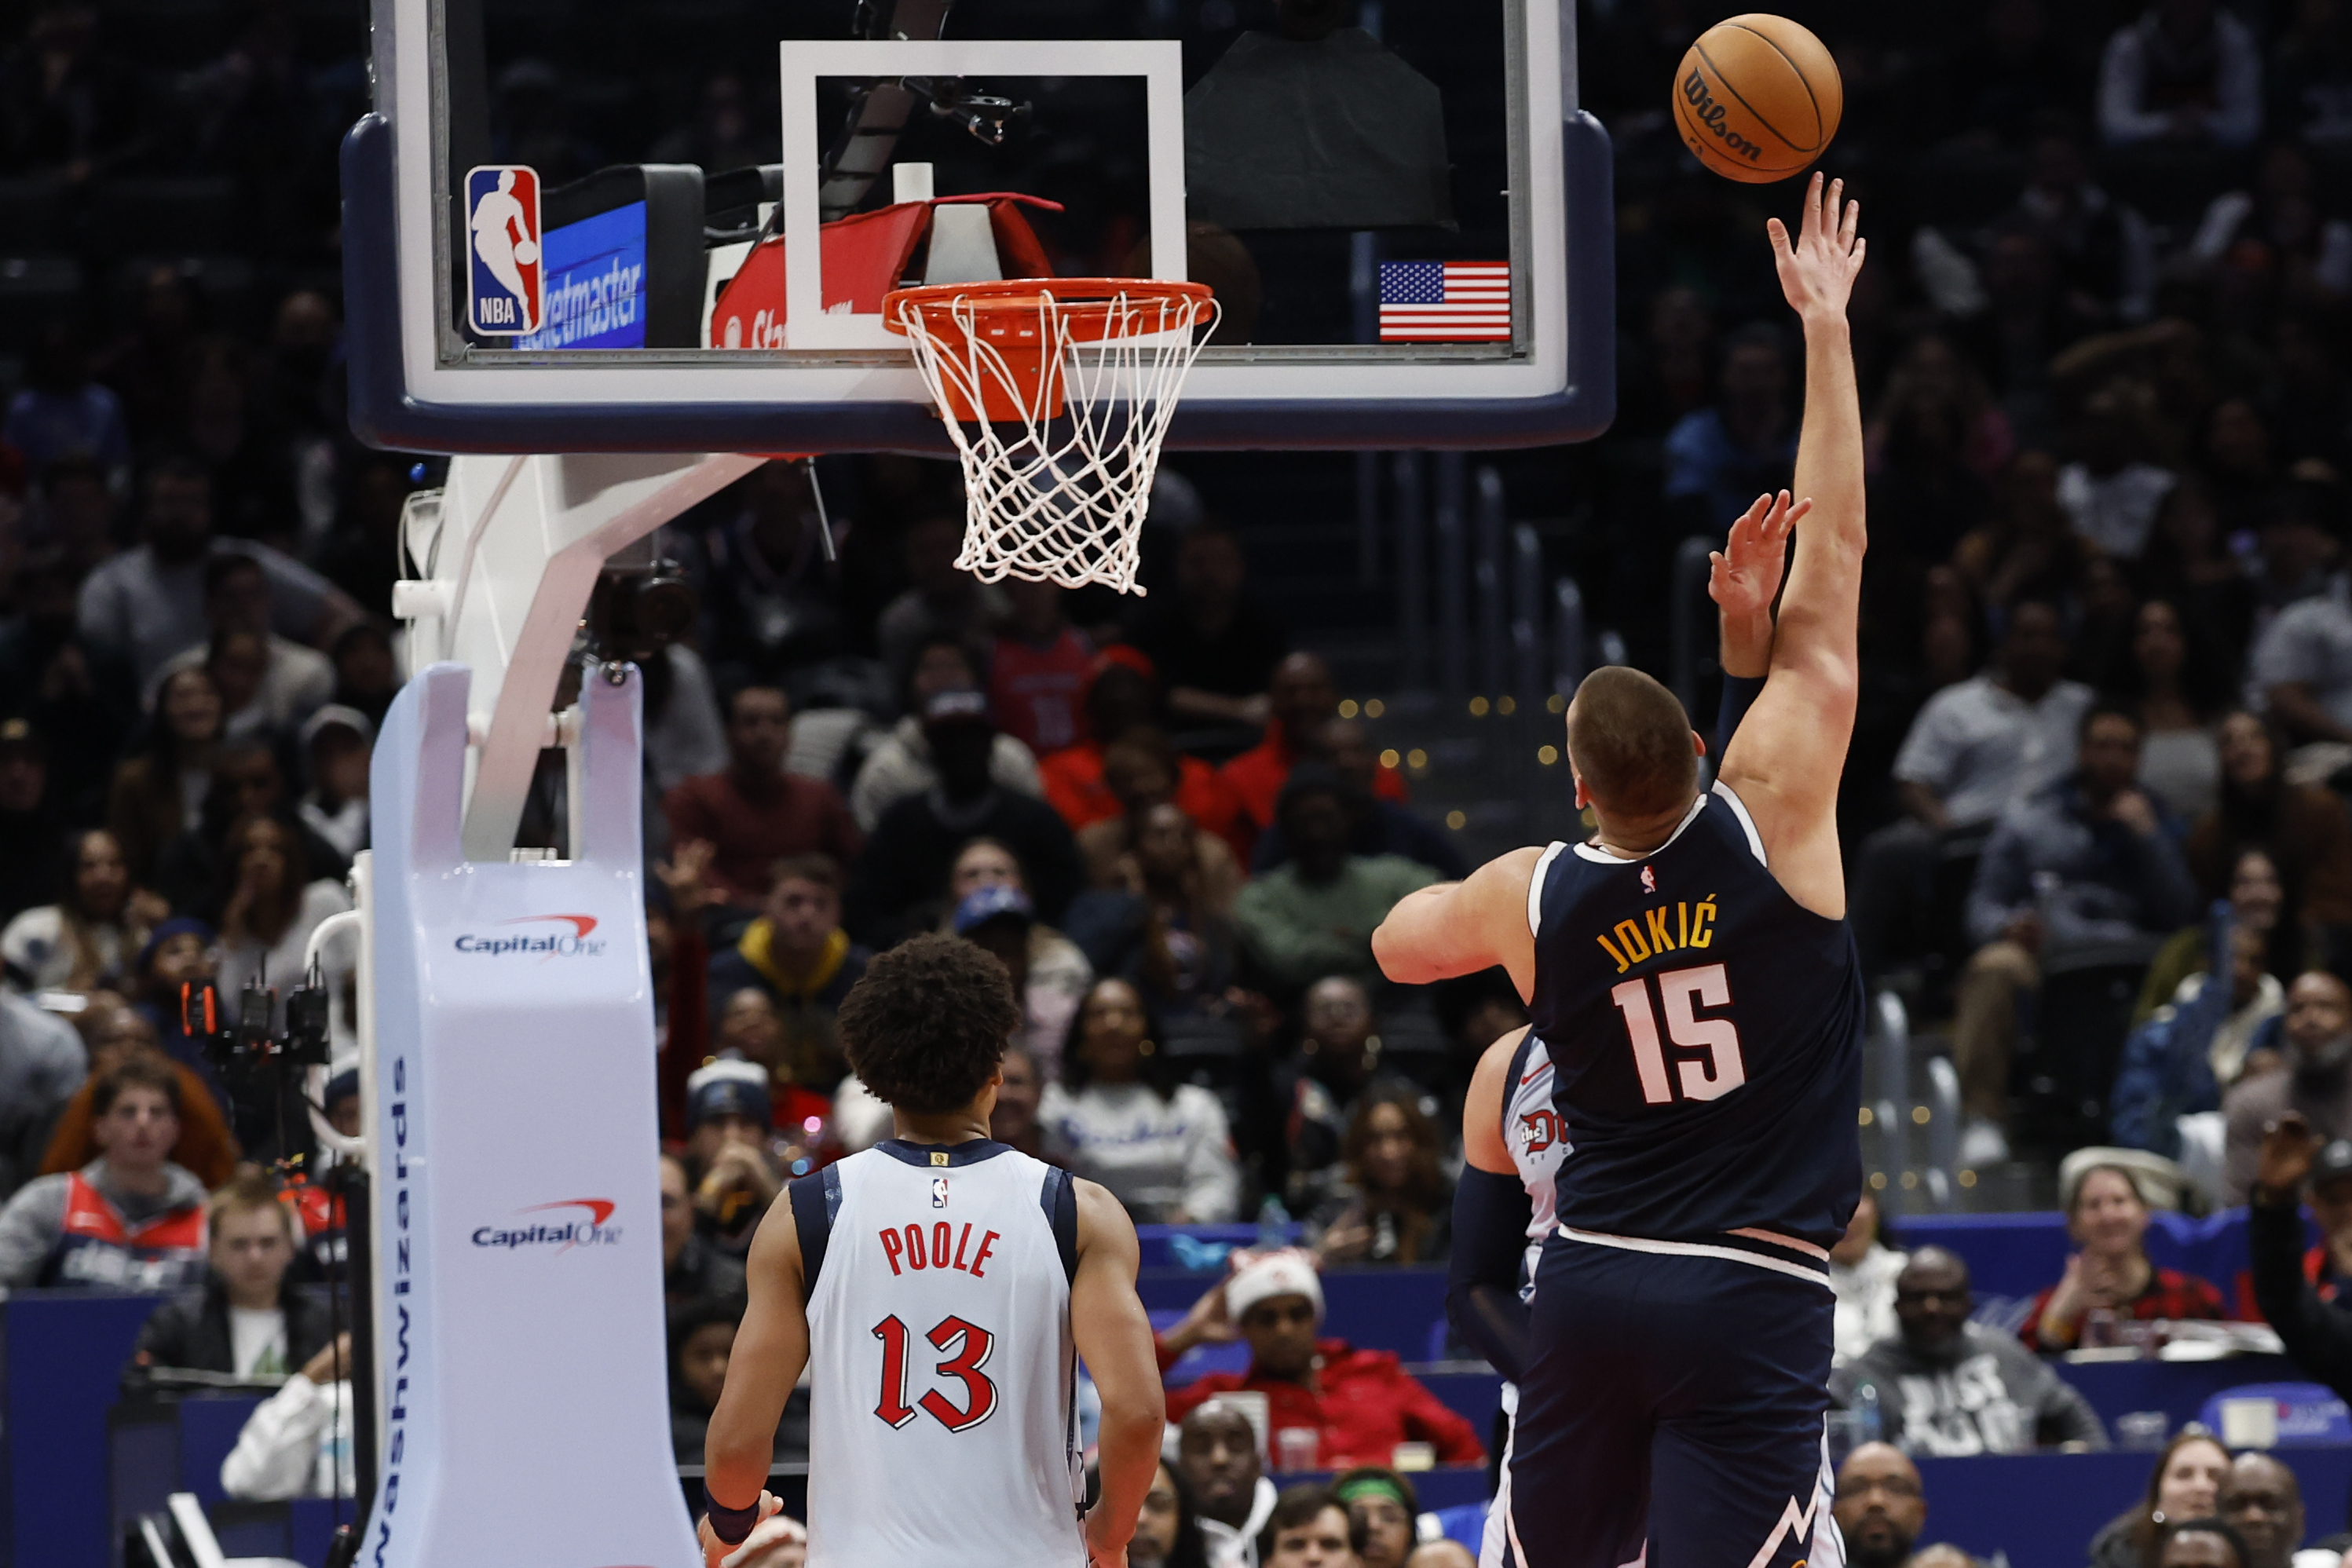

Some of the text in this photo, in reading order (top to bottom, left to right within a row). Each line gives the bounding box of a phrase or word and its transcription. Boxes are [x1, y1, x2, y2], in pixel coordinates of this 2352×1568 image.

[1684, 66, 1762, 163] Wilson
[479, 297, 516, 324] NBA
[518, 256, 642, 349] ketmaster
[1596, 893, 1718, 975] JOKIĆ
[1610, 959, 1747, 1106] 15
[1520, 1125, 1542, 1144] the
[879, 1221, 1001, 1279] POOLE
[871, 1313, 999, 1435] 13
